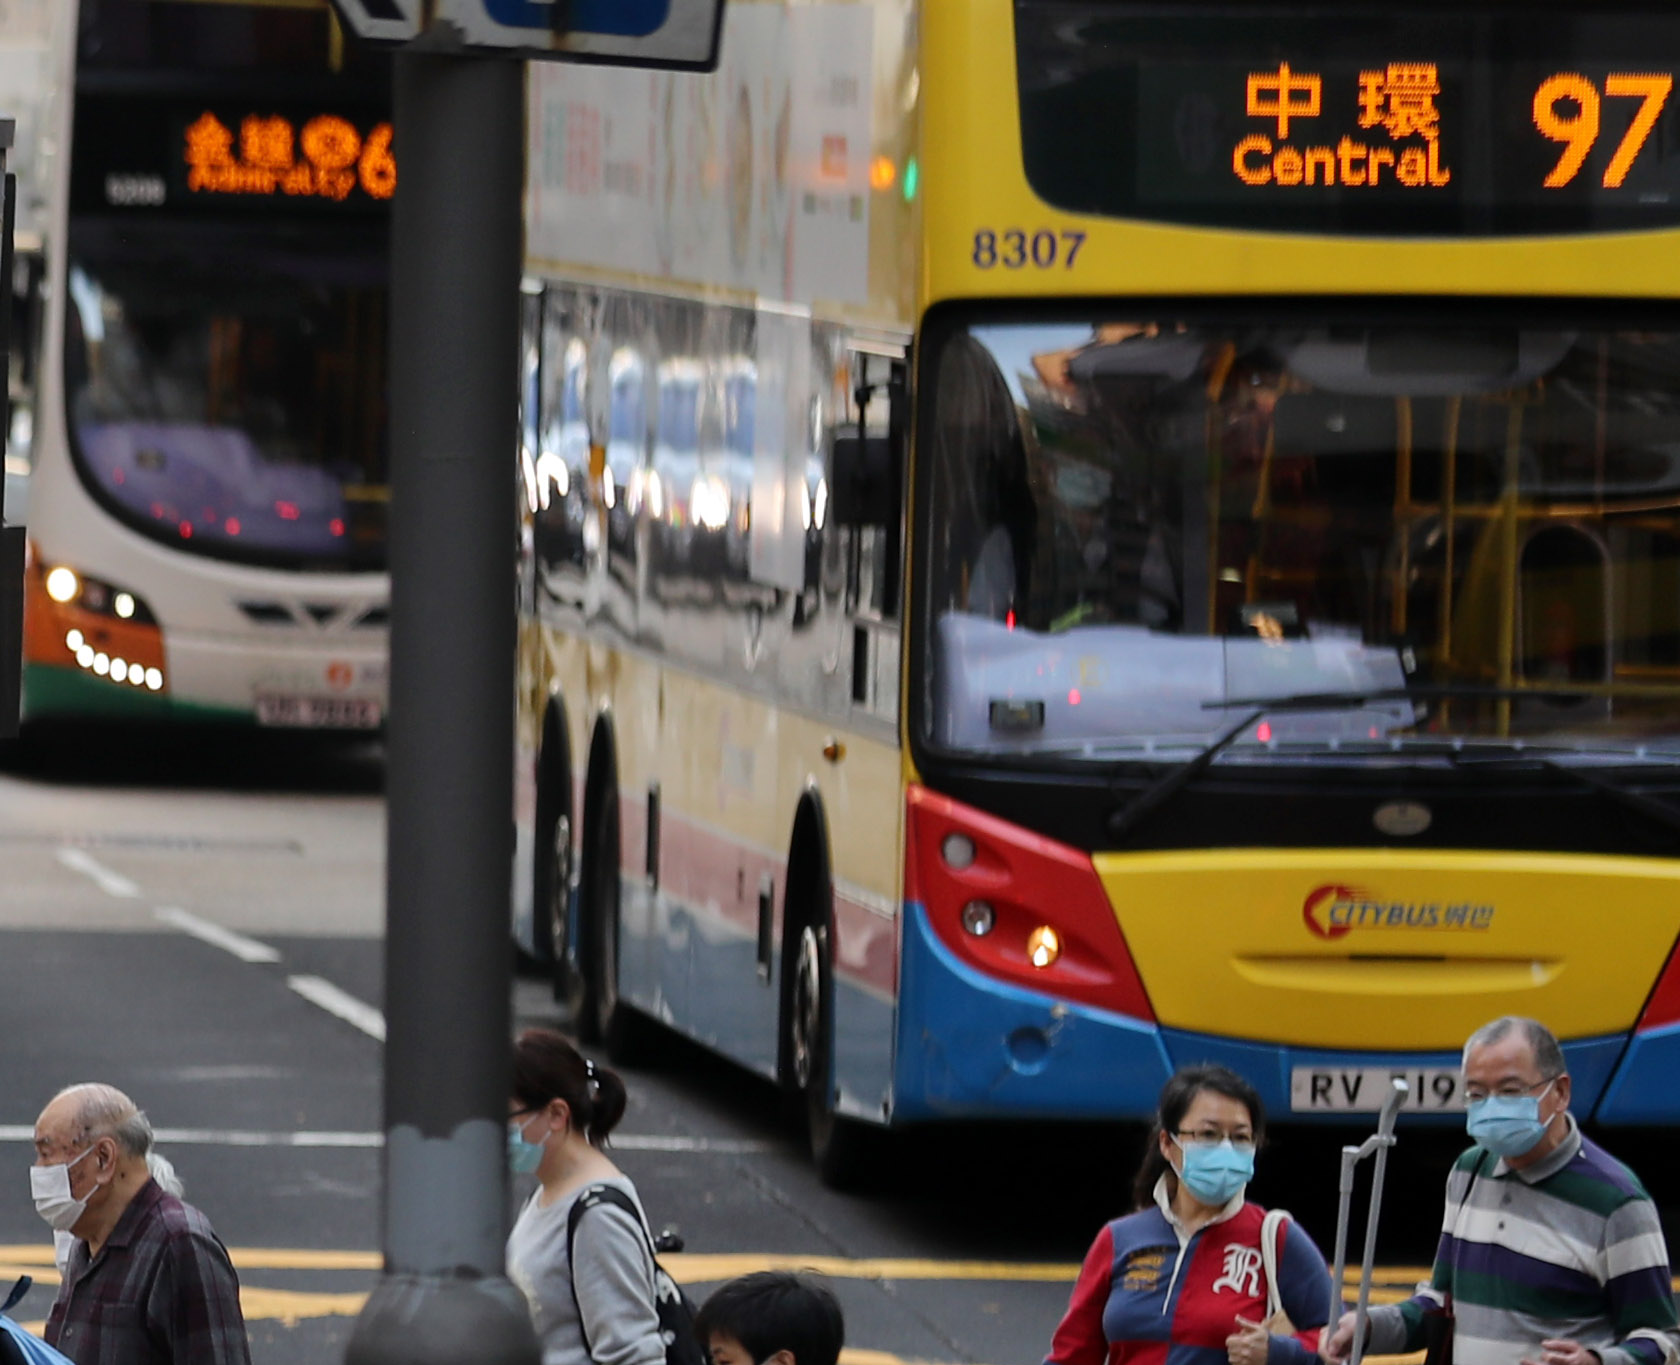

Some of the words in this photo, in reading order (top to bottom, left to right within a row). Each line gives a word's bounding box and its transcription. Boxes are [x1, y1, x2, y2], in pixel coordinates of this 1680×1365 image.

[1244, 60, 1441, 141] 中環
[1532, 72, 1673, 189] 97
[1231, 133, 1450, 188] Central
[971, 230, 1087, 270] 8307
[1329, 899, 1442, 927] CITYBUS
[1310, 1073, 1363, 1106] RV
